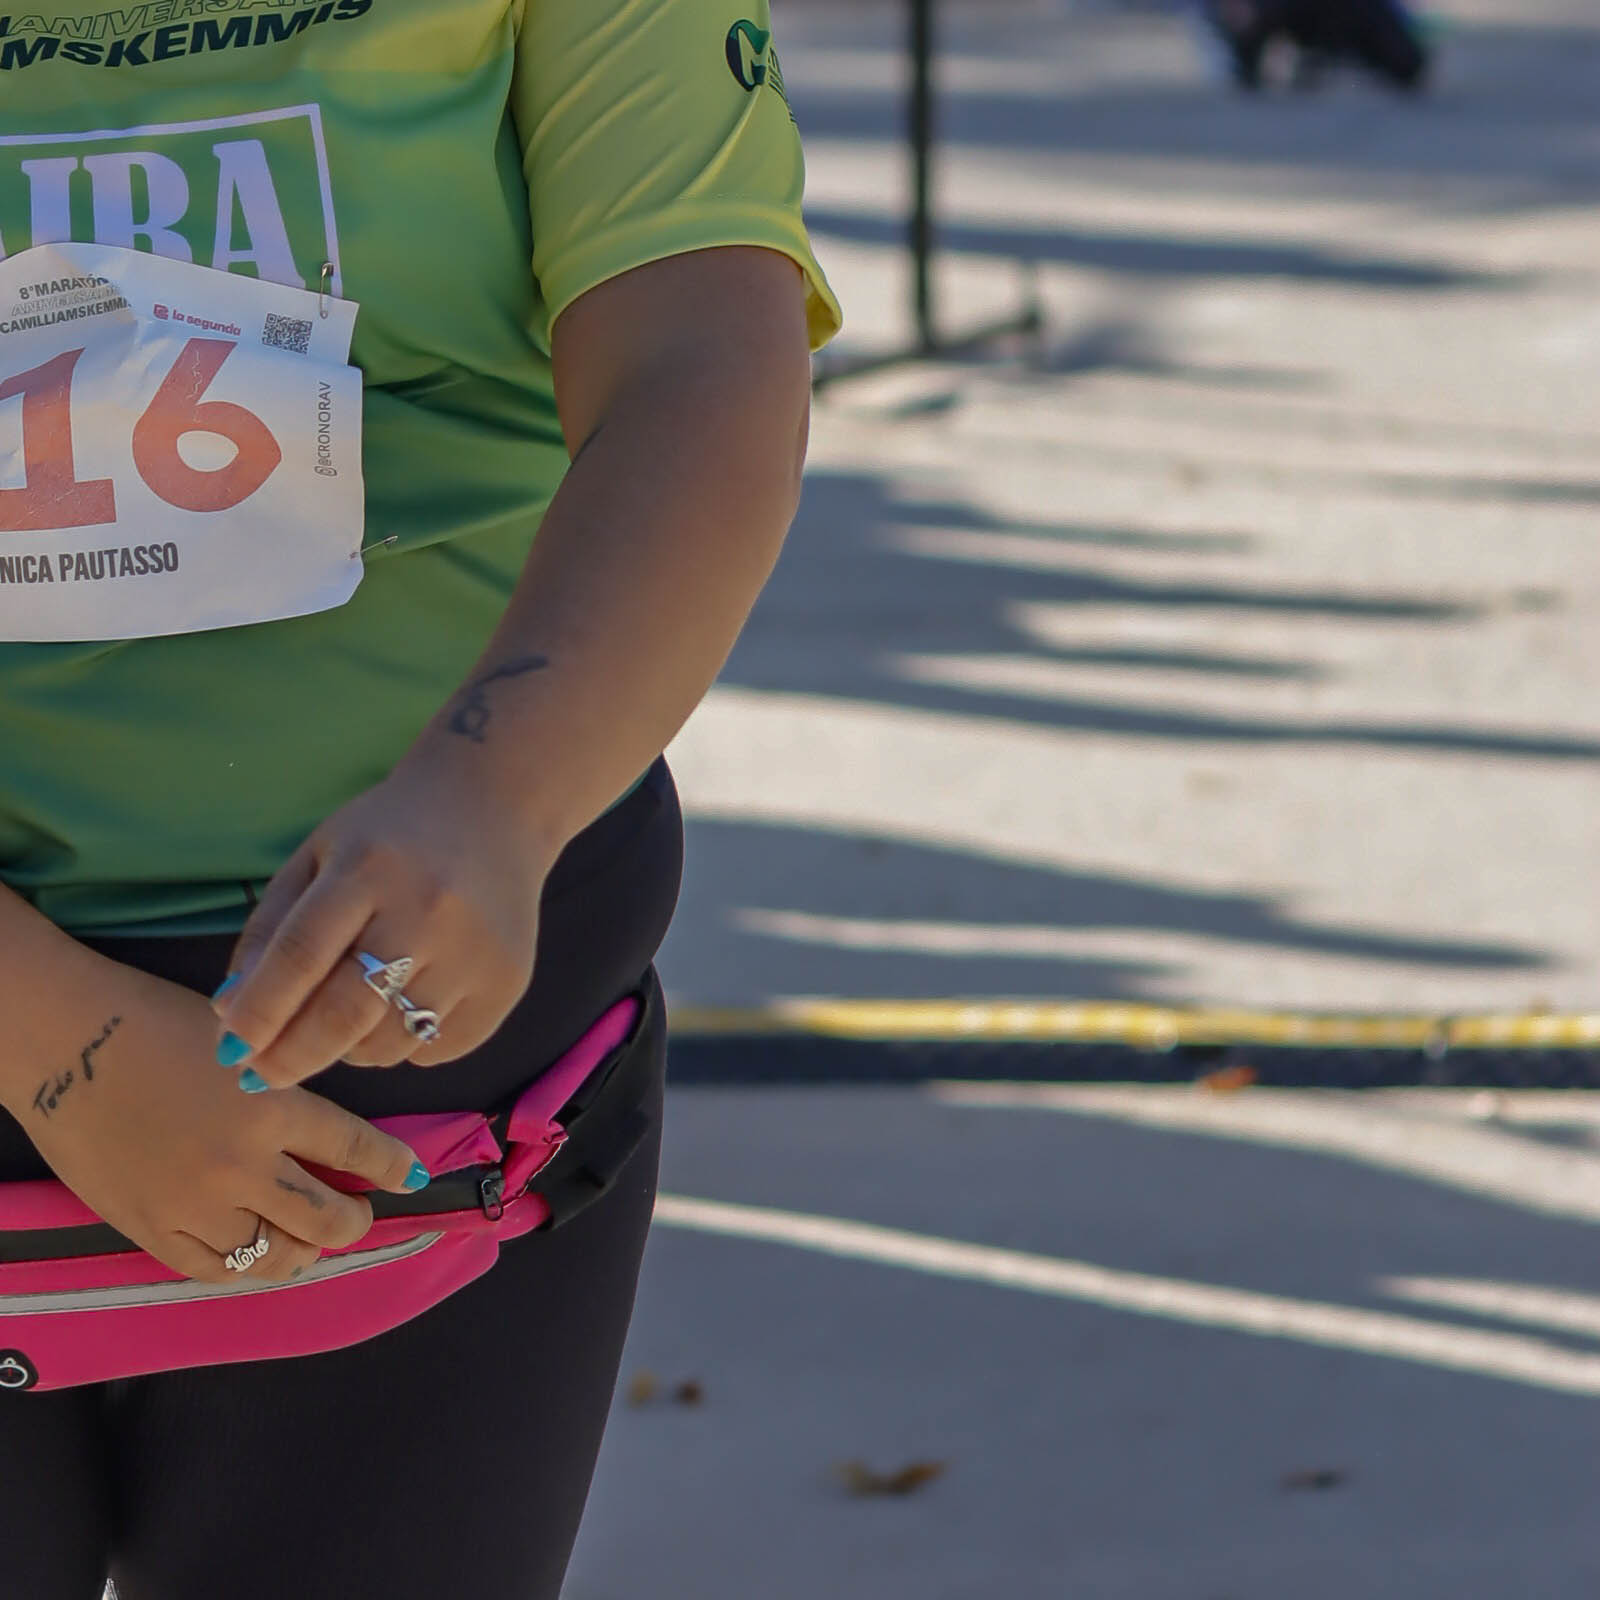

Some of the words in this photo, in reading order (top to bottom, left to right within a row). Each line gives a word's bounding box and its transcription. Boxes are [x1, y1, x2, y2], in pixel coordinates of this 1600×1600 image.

[0, 296, 132, 334] CAWILLIAMSKEMMI
[186, 314, 241, 337] segunda
[59, 541, 180, 583] PAUTASSO
